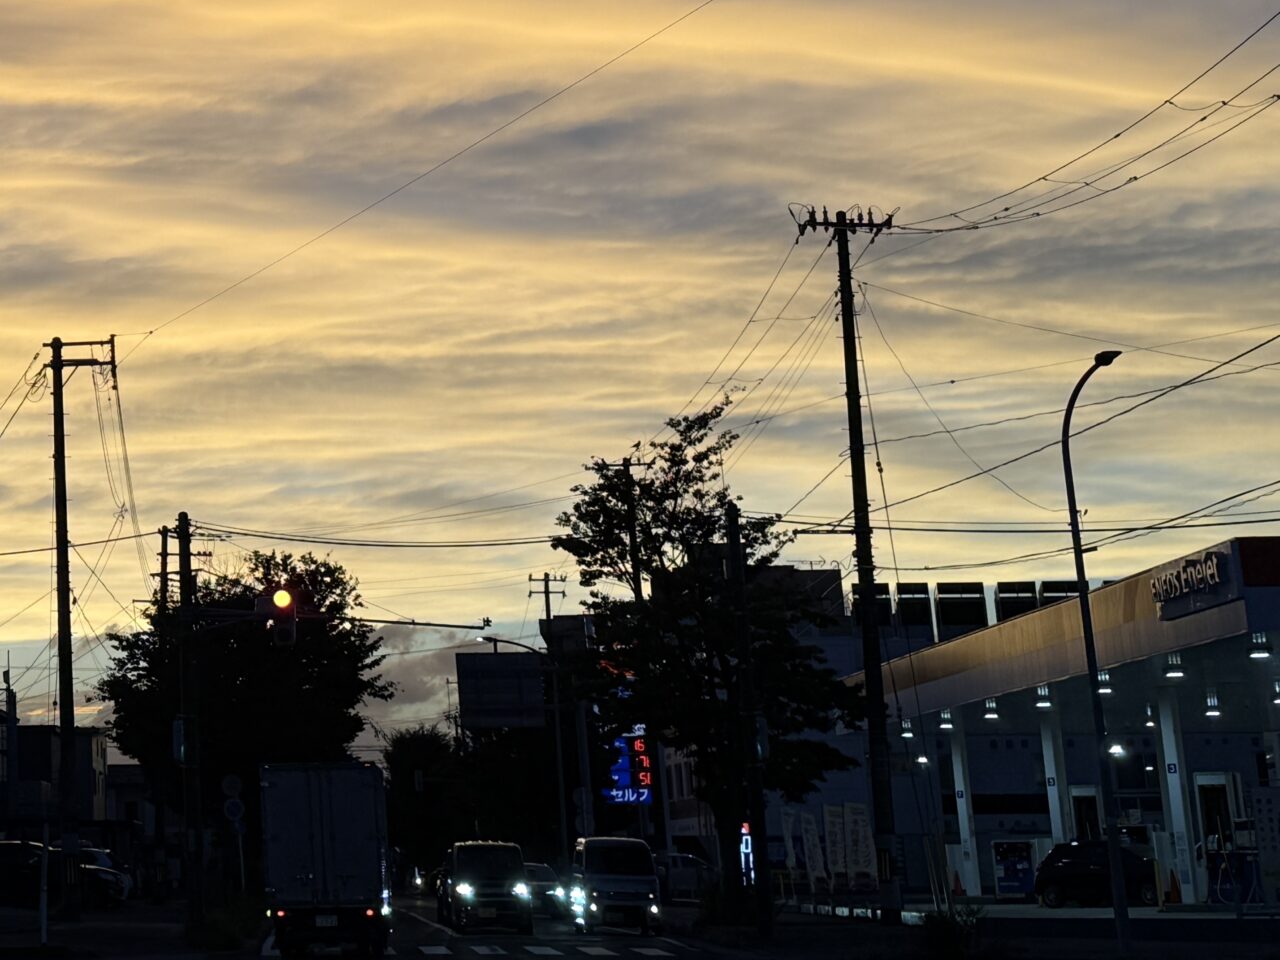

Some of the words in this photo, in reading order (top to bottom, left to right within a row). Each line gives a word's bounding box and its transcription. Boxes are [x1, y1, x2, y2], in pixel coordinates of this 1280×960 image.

[1150, 569, 1180, 601] ENEOS
[610, 788, 649, 802] セルフ
